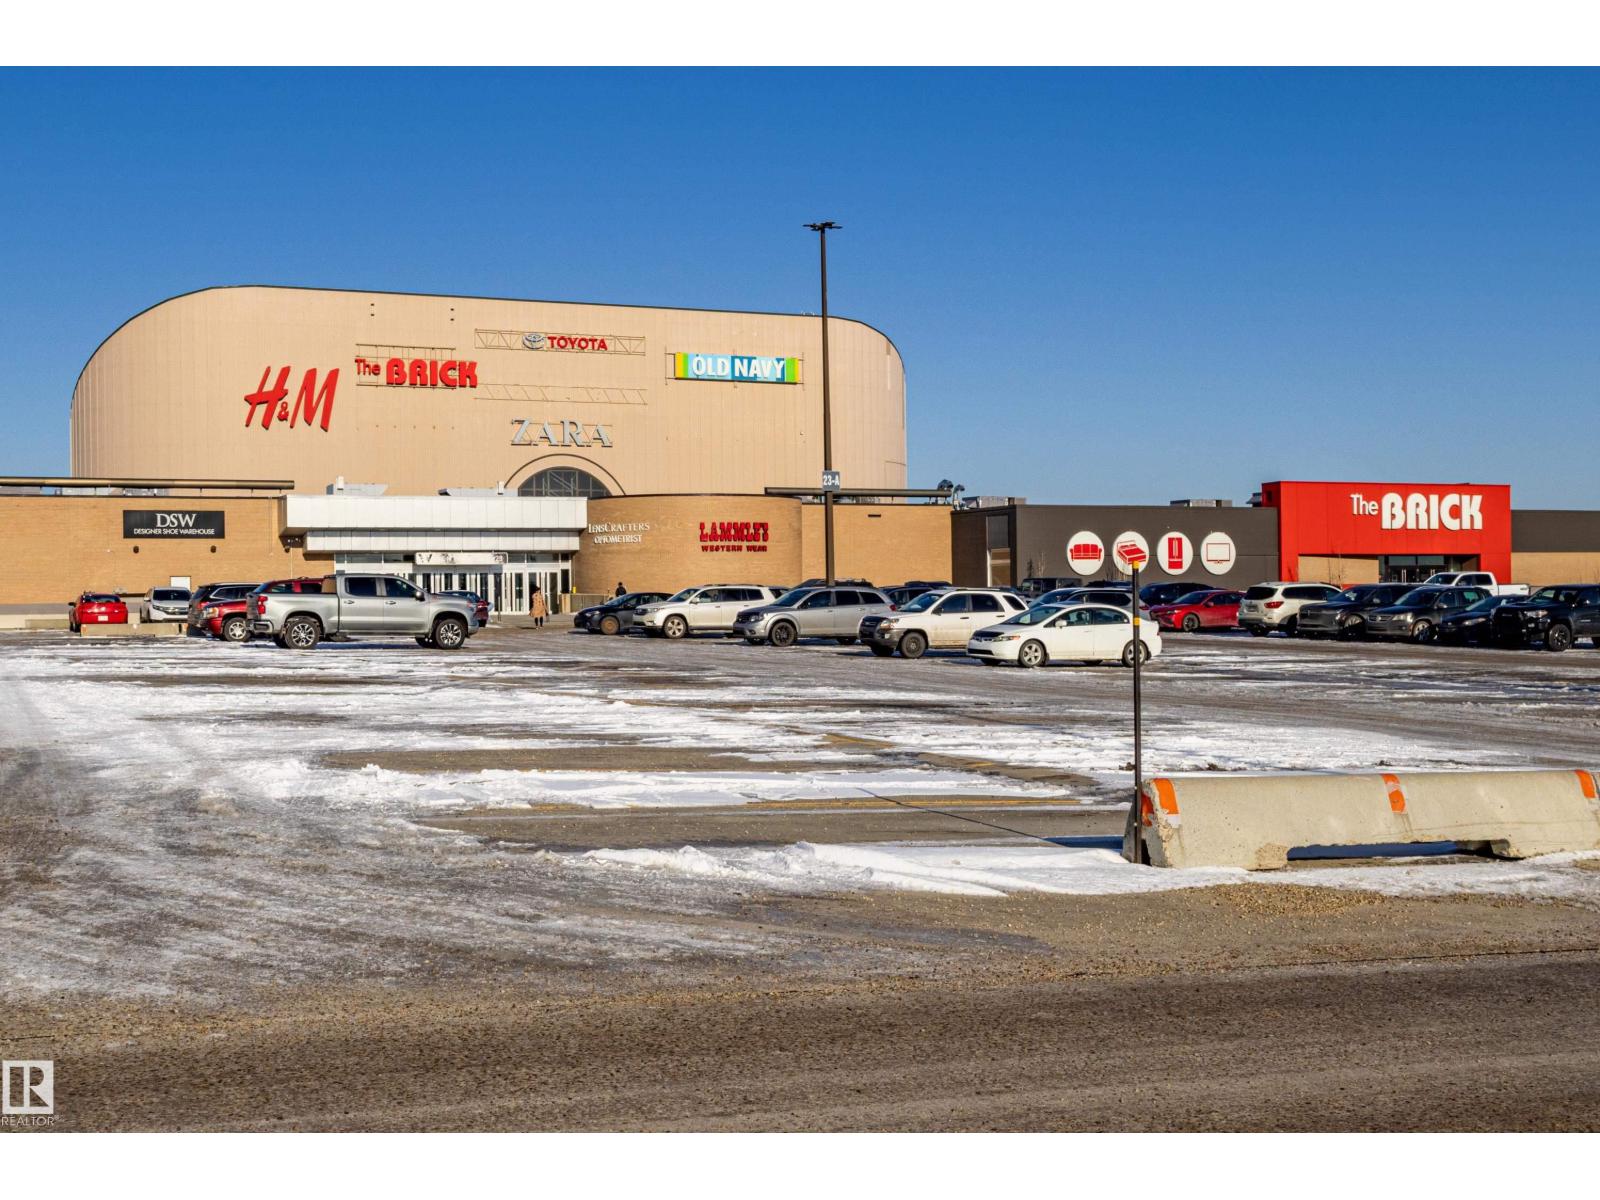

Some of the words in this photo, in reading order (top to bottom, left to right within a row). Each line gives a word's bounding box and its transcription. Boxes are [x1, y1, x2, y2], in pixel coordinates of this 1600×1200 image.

[547, 336, 608, 351] TOYOTA
[354, 358, 381, 376] The
[386, 357, 478, 388] BRICK
[692, 356, 730, 377] OLD
[734, 358, 785, 379] NAVY
[244, 366, 340, 433] H&M
[511, 418, 613, 447] ZARA
[823, 474, 840, 486] 23-A
[156, 513, 197, 528] DSW
[1350, 493, 1379, 516] The
[1381, 492, 1483, 531] BRICK
